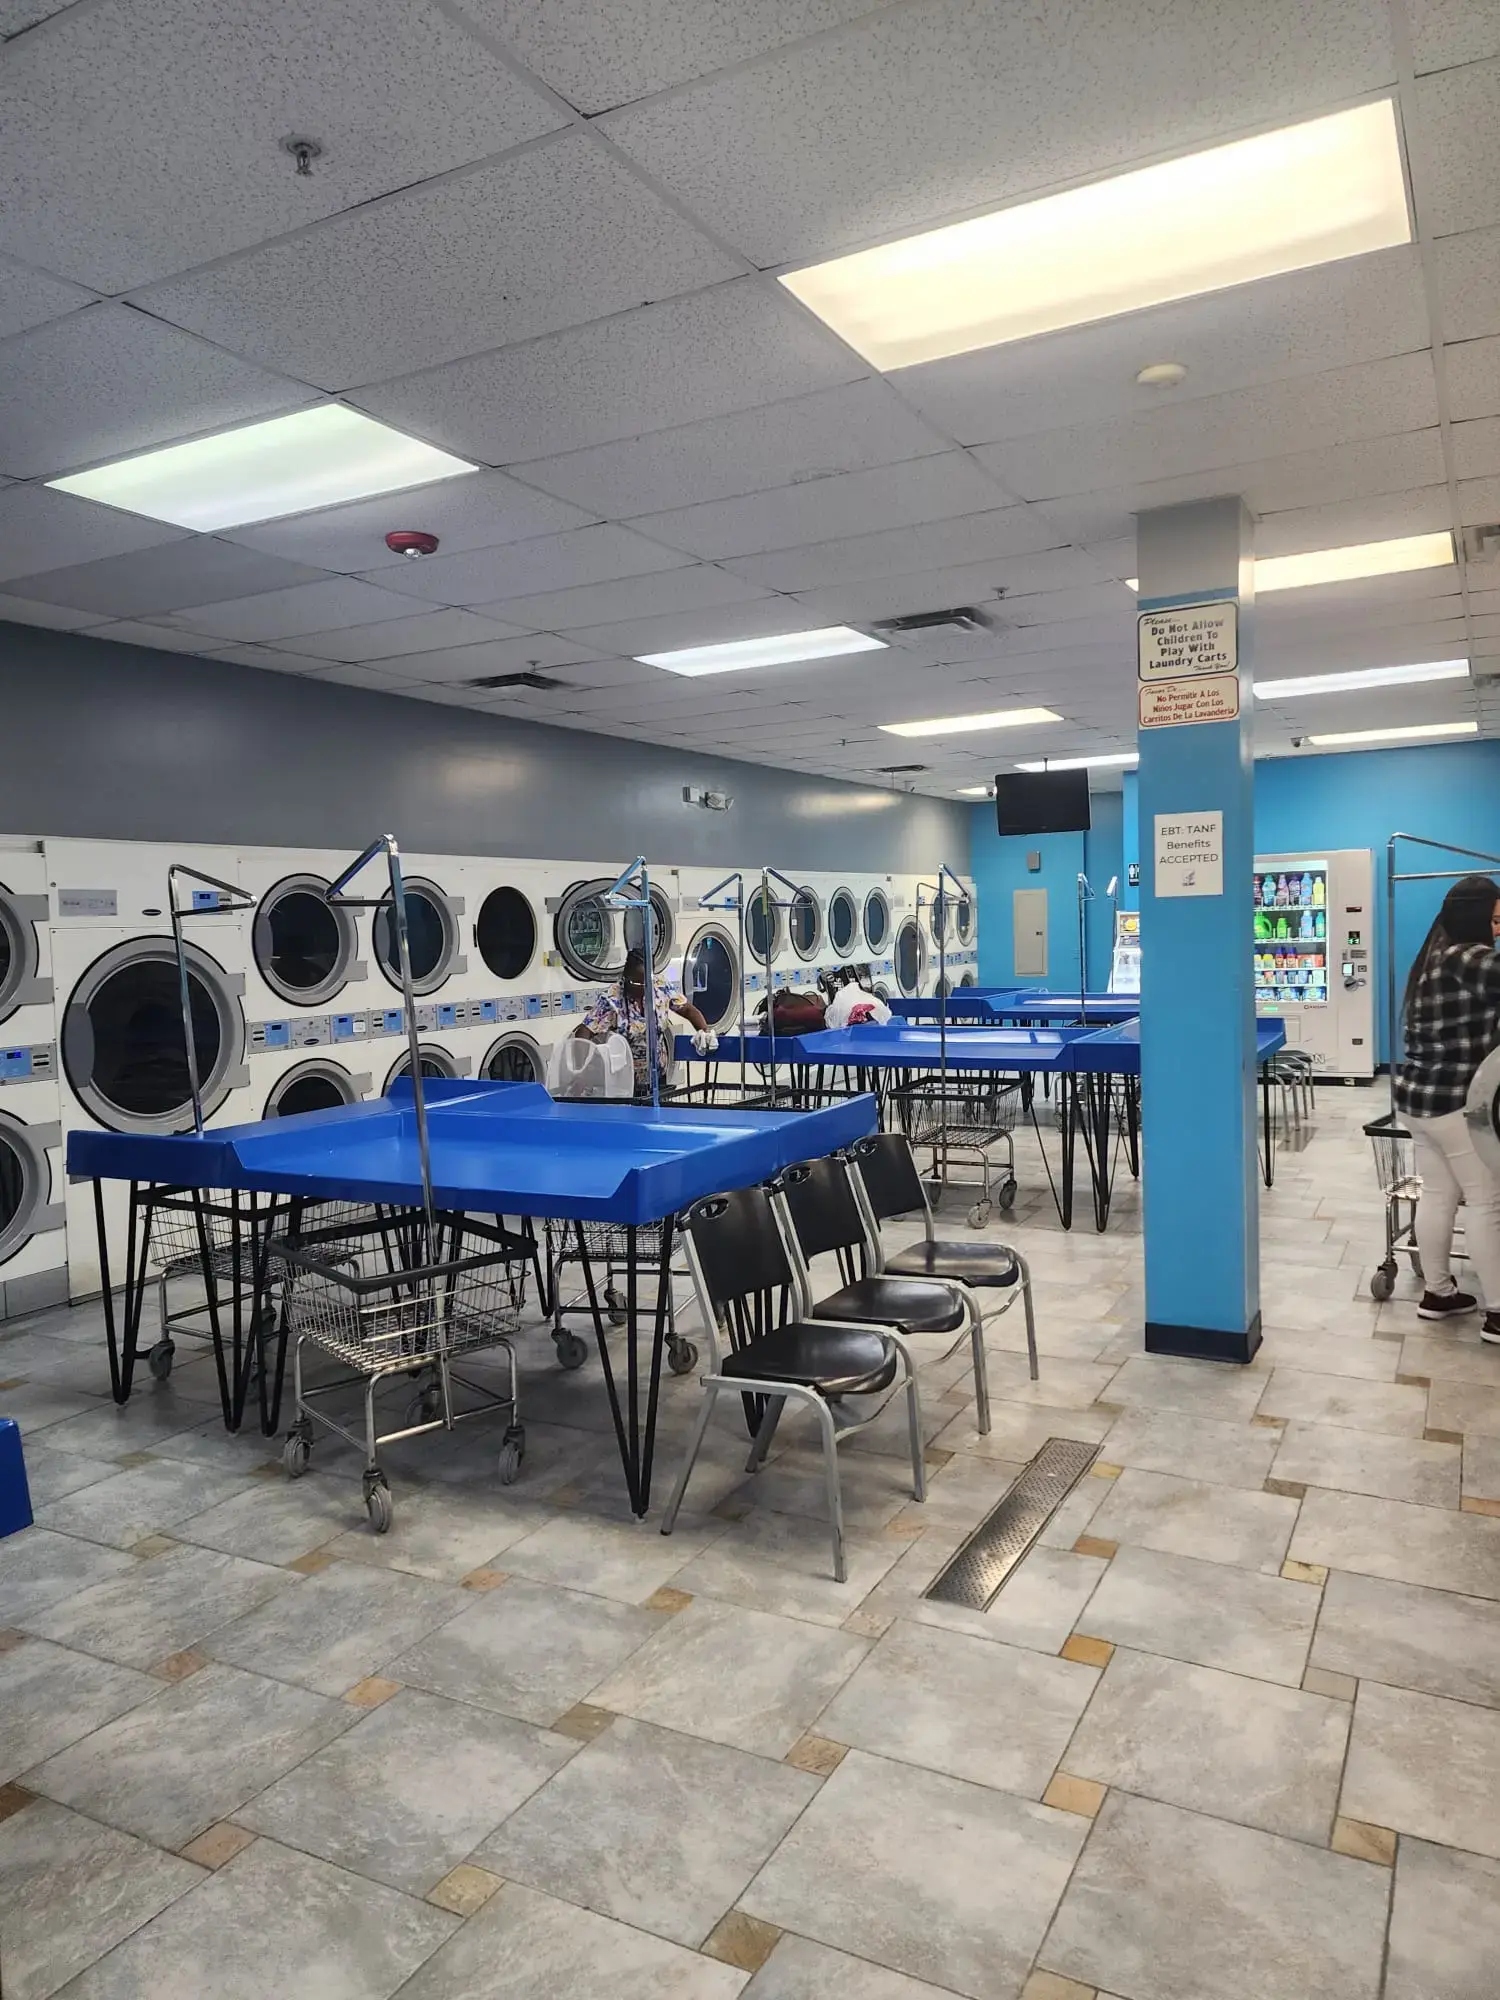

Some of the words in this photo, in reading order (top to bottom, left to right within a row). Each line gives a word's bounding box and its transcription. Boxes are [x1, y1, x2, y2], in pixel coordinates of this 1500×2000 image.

[1151, 626, 1165, 636] Do
[1169, 624, 1188, 634] Not
[1192, 619, 1224, 631] Allow
[1157, 633, 1203, 646] Children
[1207, 630, 1219, 640] To
[1160, 646, 1184, 657] Play
[1188, 642, 1215, 653] With
[1149, 657, 1193, 670] Laundry
[1197, 652, 1227, 663] Carts
[1157, 695, 1167, 703] No
[1168, 692, 1198, 702] Permitir
[1200, 690, 1206, 698] A
[1207, 689, 1220, 697] Los
[1173, 702, 1194, 711] Jugar
[1196, 700, 1210, 708] Con
[1211, 698, 1224, 707] Los
[1143, 714, 1171, 724] Carritos
[1173, 713, 1183, 721] De
[1185, 711, 1193, 719] La
[1187, 824, 1216, 834] TANF
[1167, 839, 1212, 850] Benefits
[1159, 853, 1219, 865] ACCEPTED
